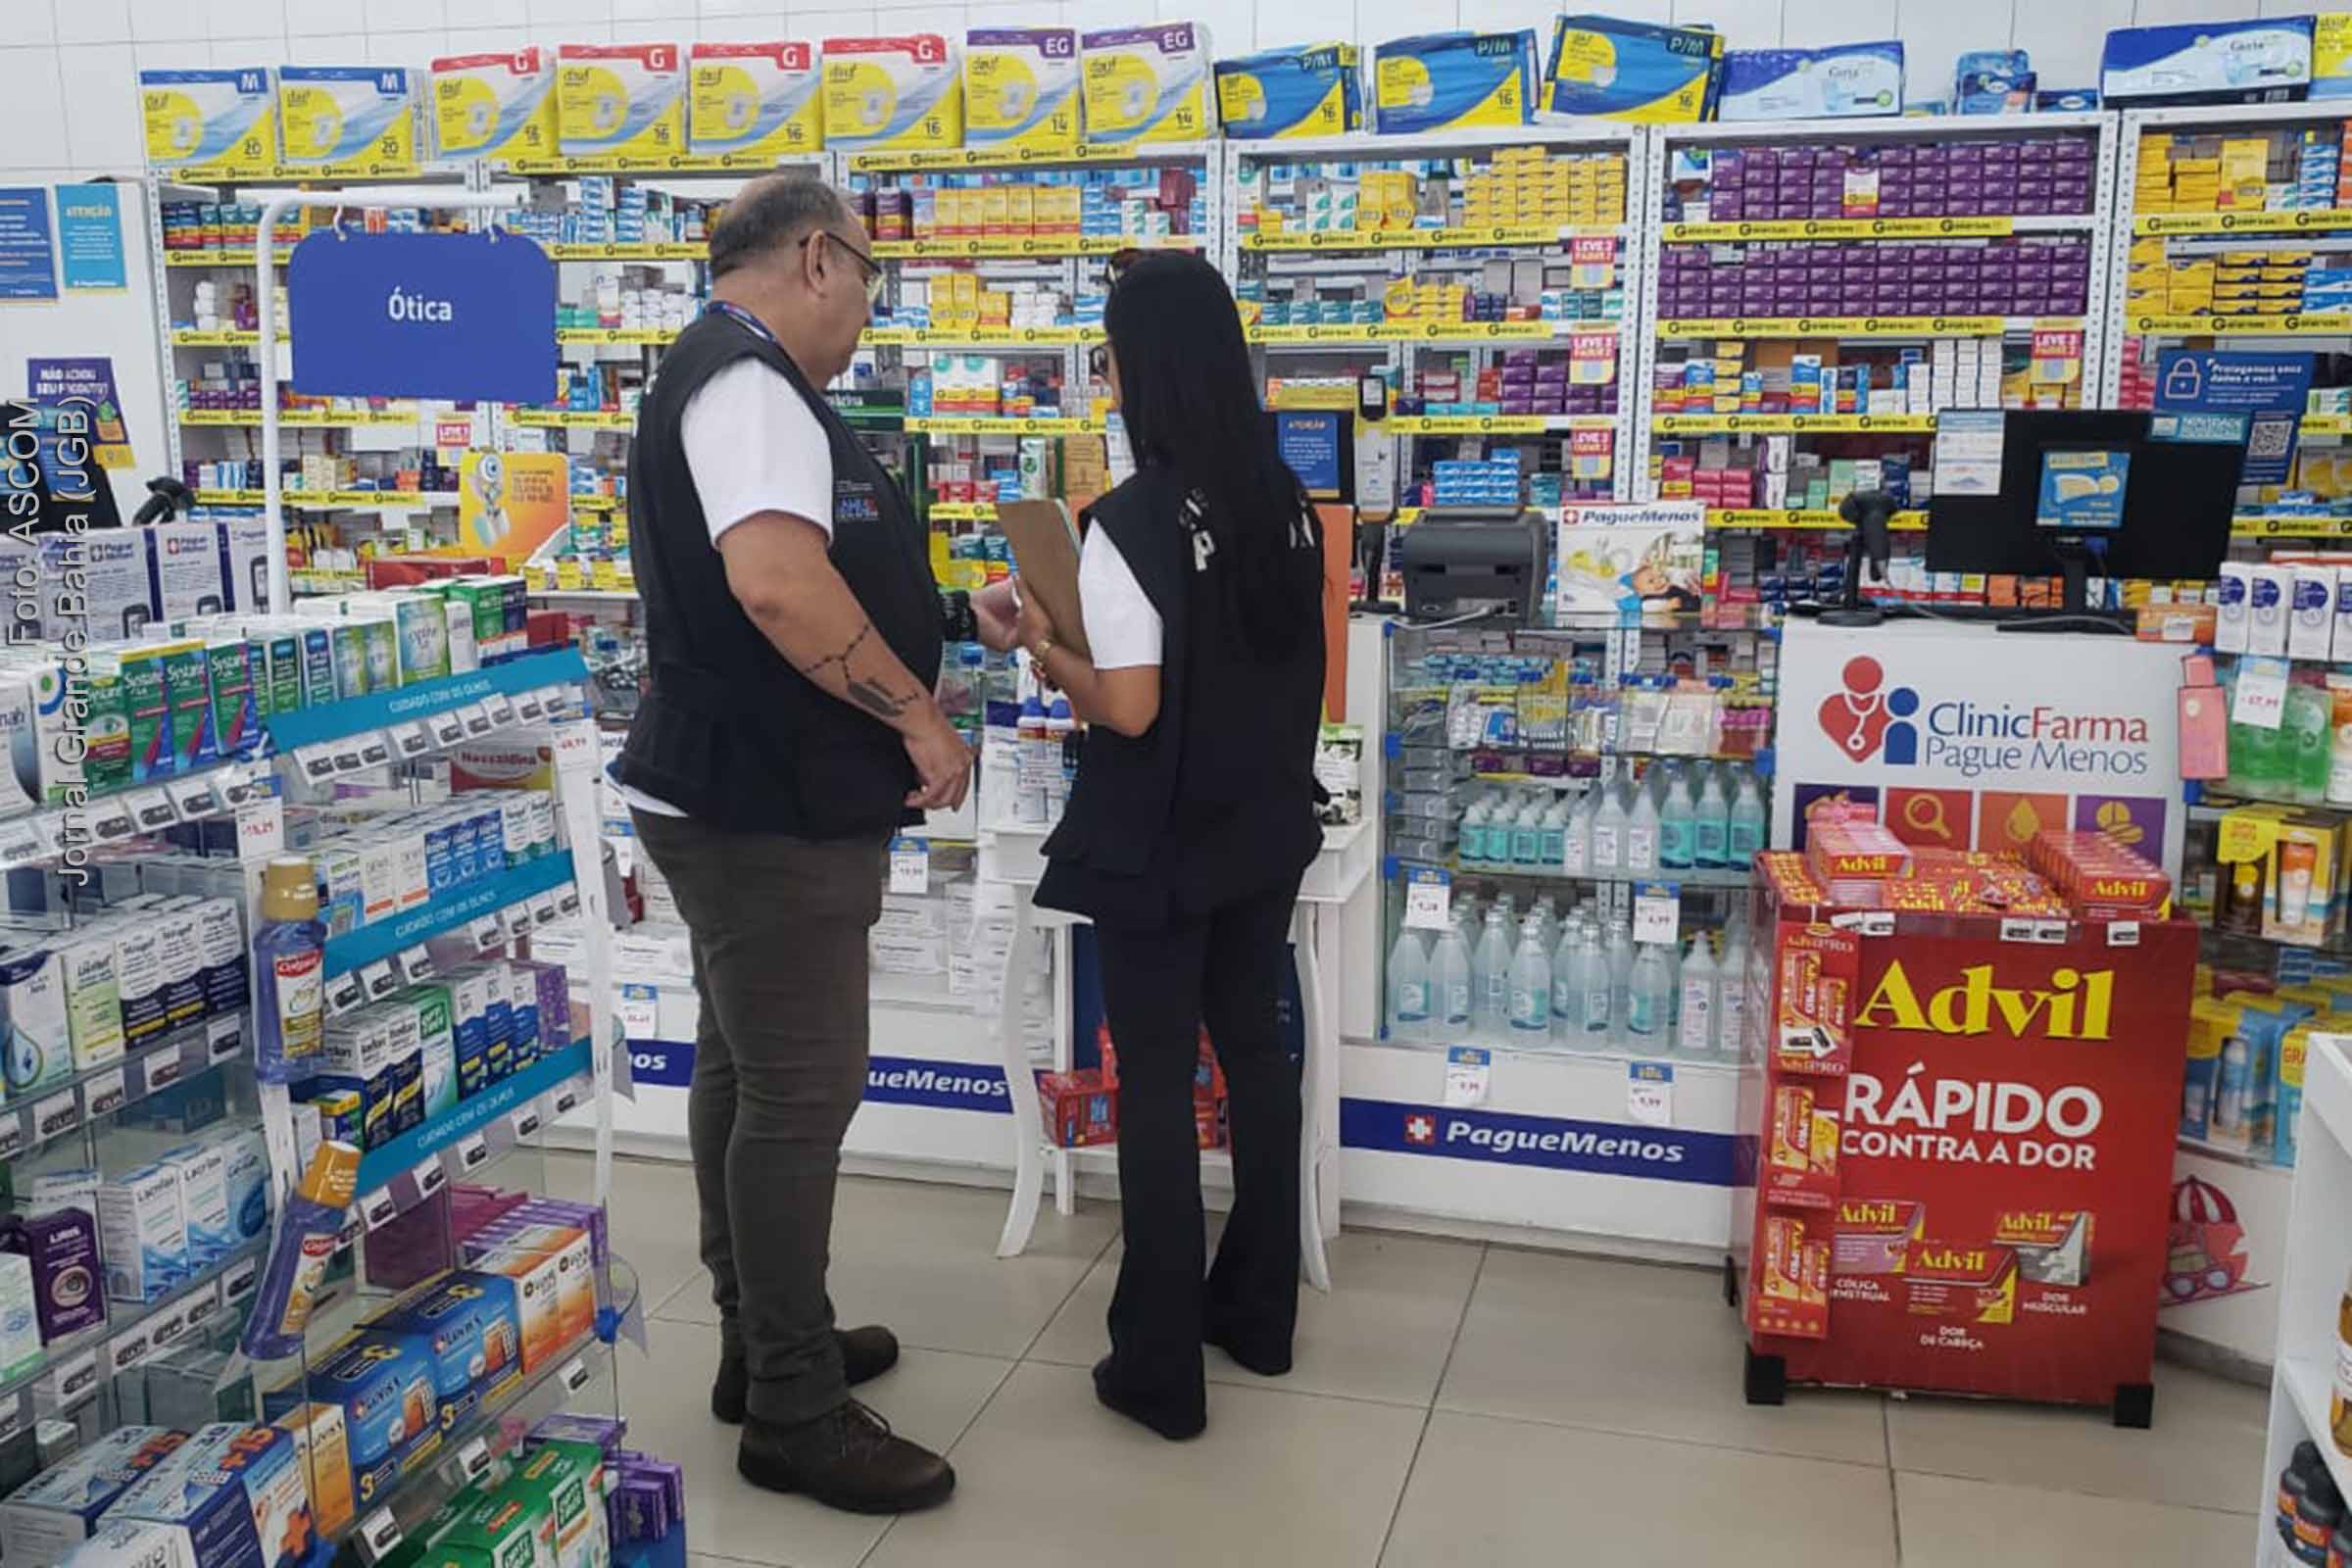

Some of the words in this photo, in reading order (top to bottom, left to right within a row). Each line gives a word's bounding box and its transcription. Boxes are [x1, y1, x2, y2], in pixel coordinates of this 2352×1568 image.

[918, 41, 932, 59] G
[1045, 37, 1069, 54] EG
[1163, 30, 1188, 50] EG
[649, 50, 665, 69] G
[783, 48, 799, 66] G
[655, 126, 670, 142] 16
[925, 121, 941, 135] 16
[389, 287, 453, 322] Ótica
[1583, 510, 1699, 525] PagueMenos
[1929, 702, 2148, 743] ClinicFarma
[1926, 737, 2022, 776] Pague
[2031, 743, 2148, 774] Menos
[1838, 855, 1887, 872] Advil
[2091, 879, 2149, 897] Advil
[1854, 958, 2115, 1041] Advil
[1843, 1061, 2103, 1138] RÁPIDO
[1446, 1120, 1686, 1163] PagueMenos
[1840, 1131, 1982, 1162] CONTRA
[1984, 1140, 2012, 1164] A
[2018, 1141, 2097, 1170] DOR
[1835, 1202, 1896, 1224] Advil
[1997, 1212, 2051, 1232] Advil
[1913, 1248, 1985, 1271] Advil
